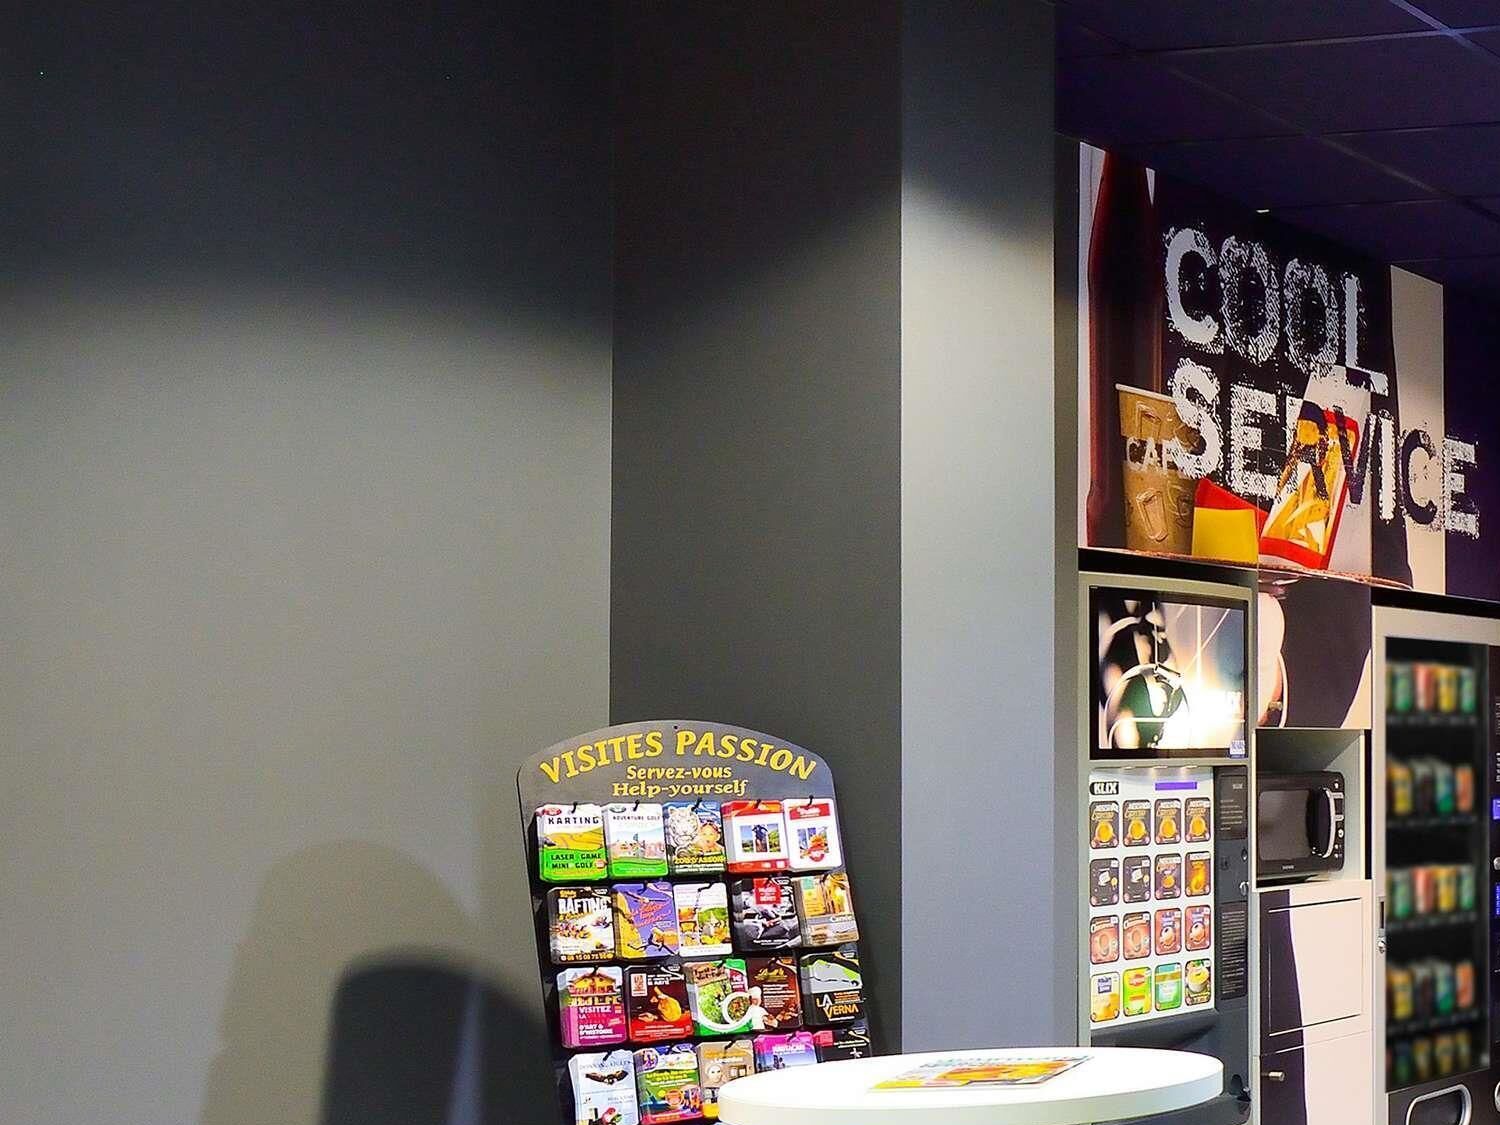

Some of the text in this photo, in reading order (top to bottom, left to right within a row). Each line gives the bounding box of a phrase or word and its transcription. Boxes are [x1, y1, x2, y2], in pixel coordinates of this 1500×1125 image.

[1163, 224, 1388, 397] COOL
[1168, 357, 1480, 540] SERVICE
[539, 731, 817, 784] VISITES PASSION
[626, 765, 732, 780] Servez-vous
[612, 780, 748, 798] Help-yourself
[1094, 782, 1118, 795] KLIX
[548, 816, 599, 825] KARTING
[579, 1006, 611, 1014] VISITEZ
[823, 1004, 859, 1019] VERNA
